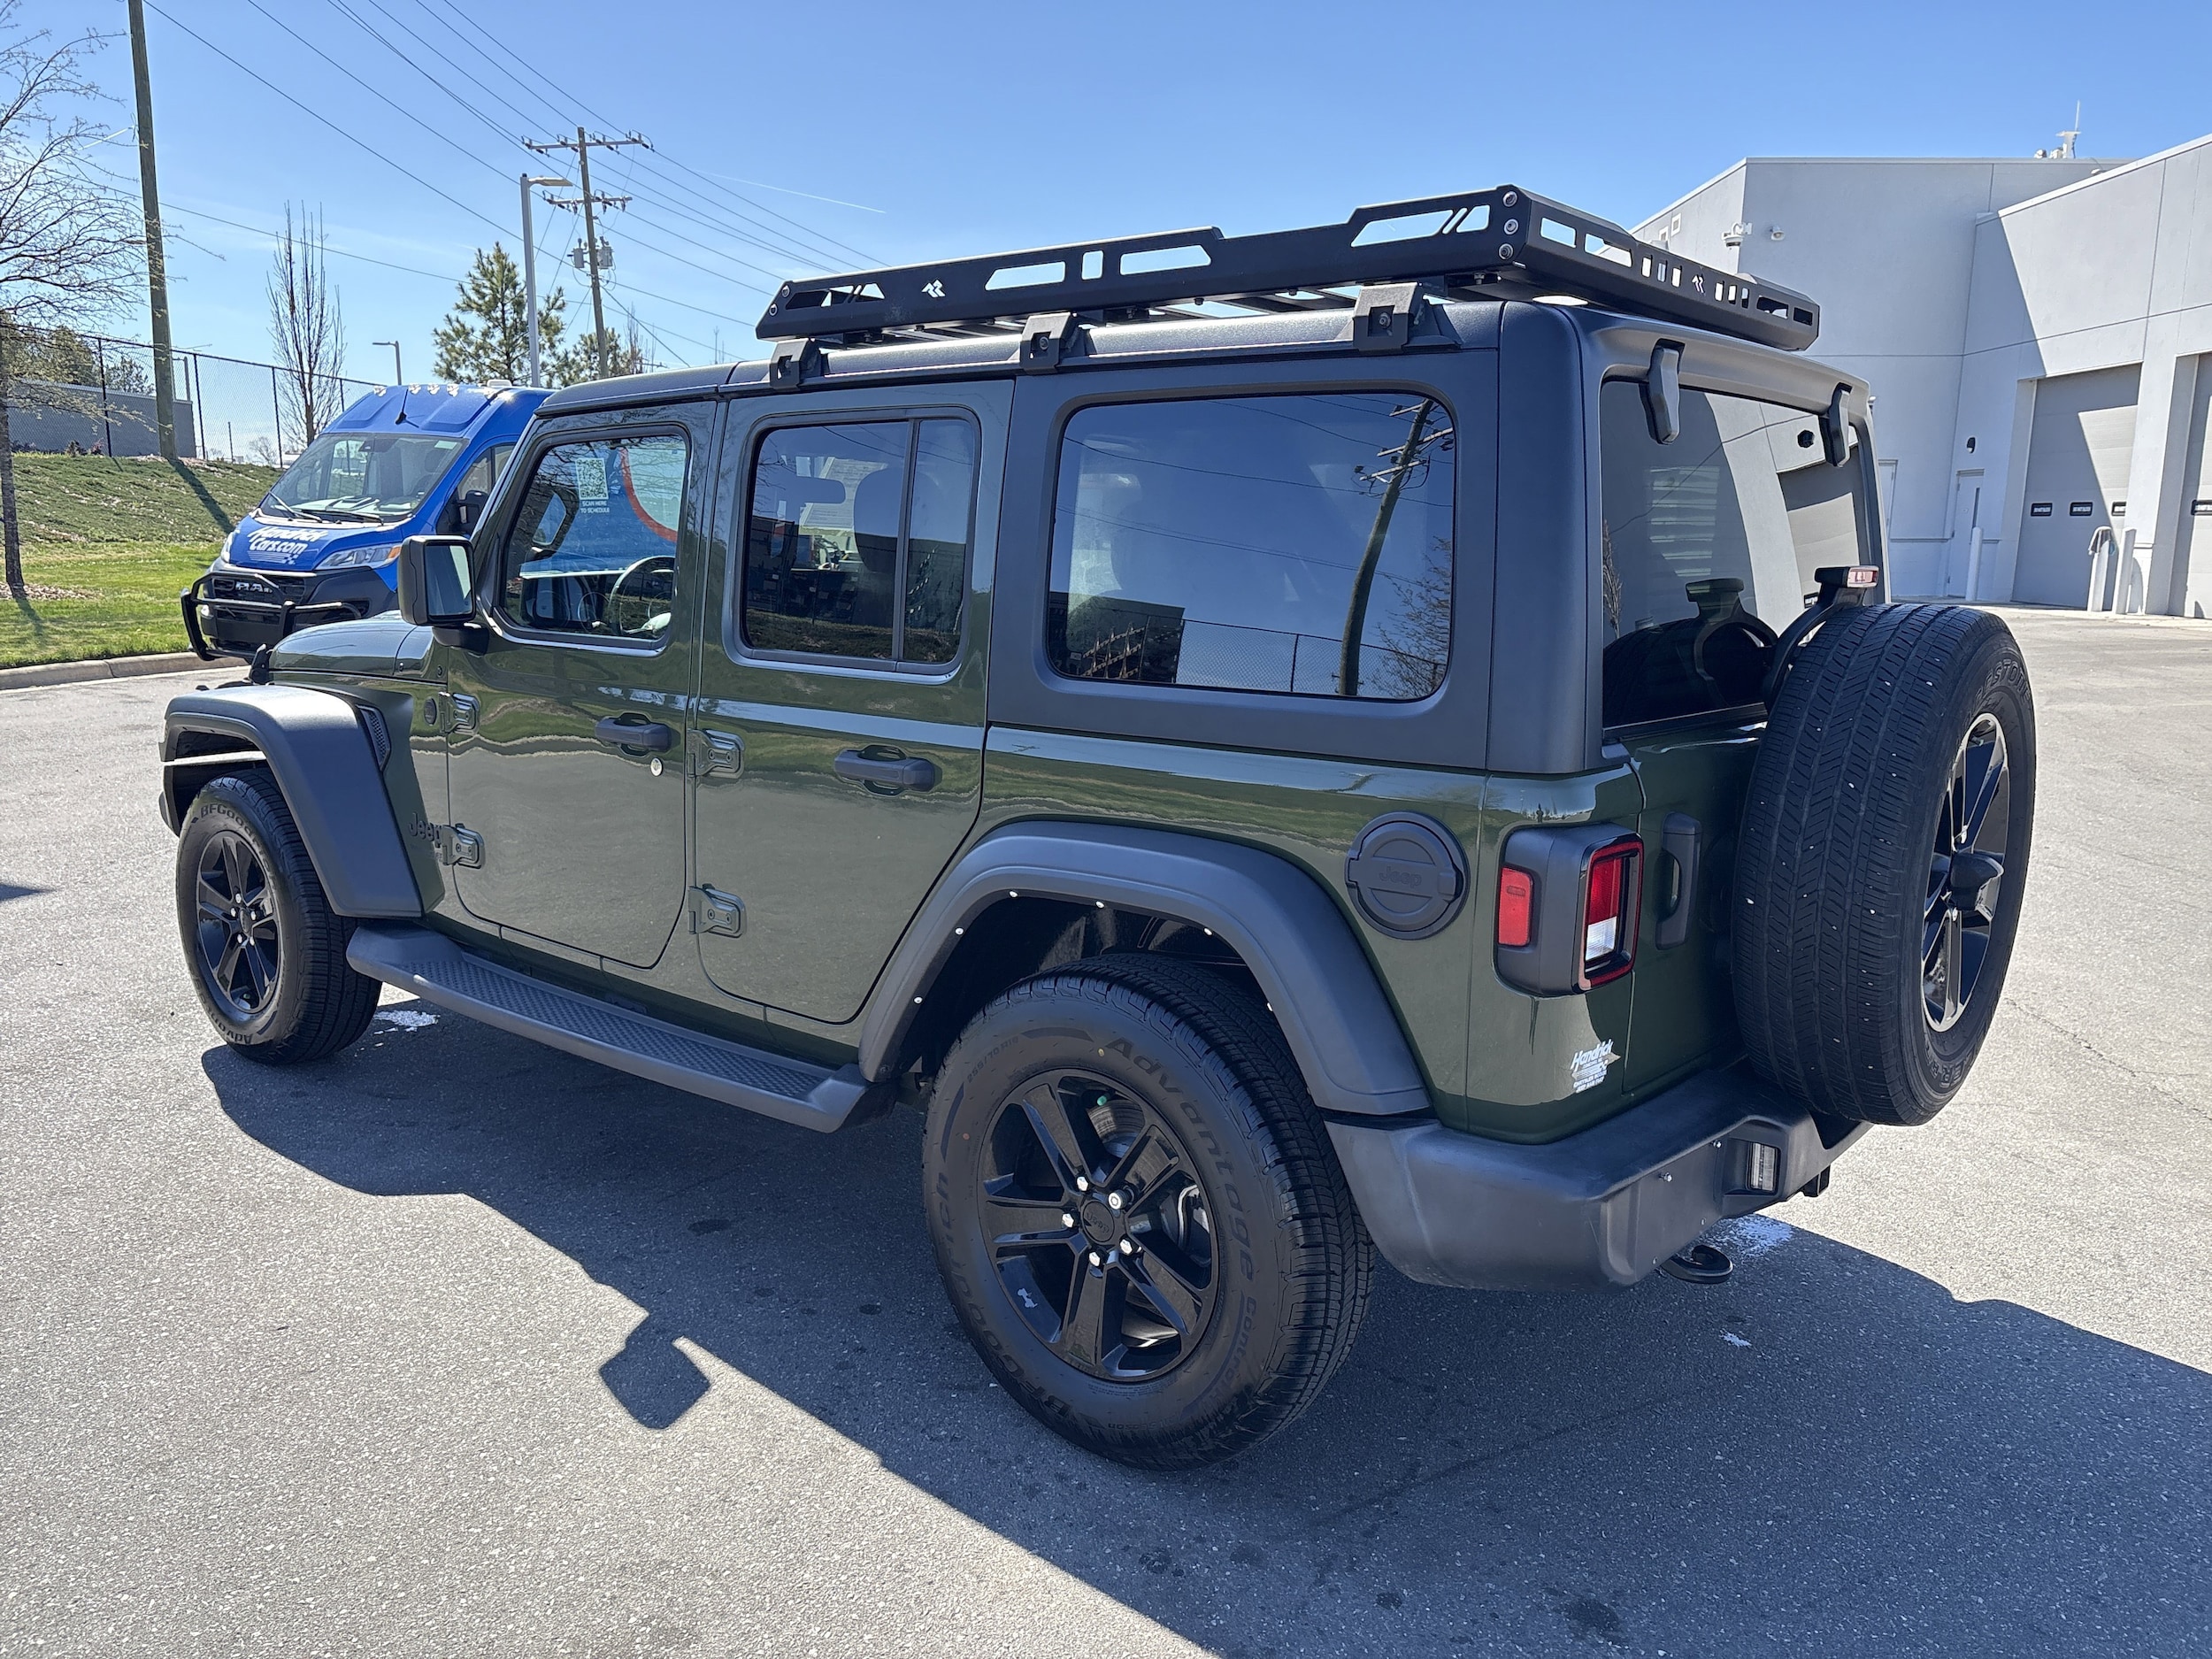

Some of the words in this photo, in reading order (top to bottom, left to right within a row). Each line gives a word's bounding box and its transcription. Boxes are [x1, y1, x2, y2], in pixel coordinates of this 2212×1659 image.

[249, 538, 308, 555] Cars.com
[1379, 865, 1422, 888] Jeep
[1570, 1039, 1614, 1072] Hendrick
[1104, 1036, 1255, 1281] Advantage
